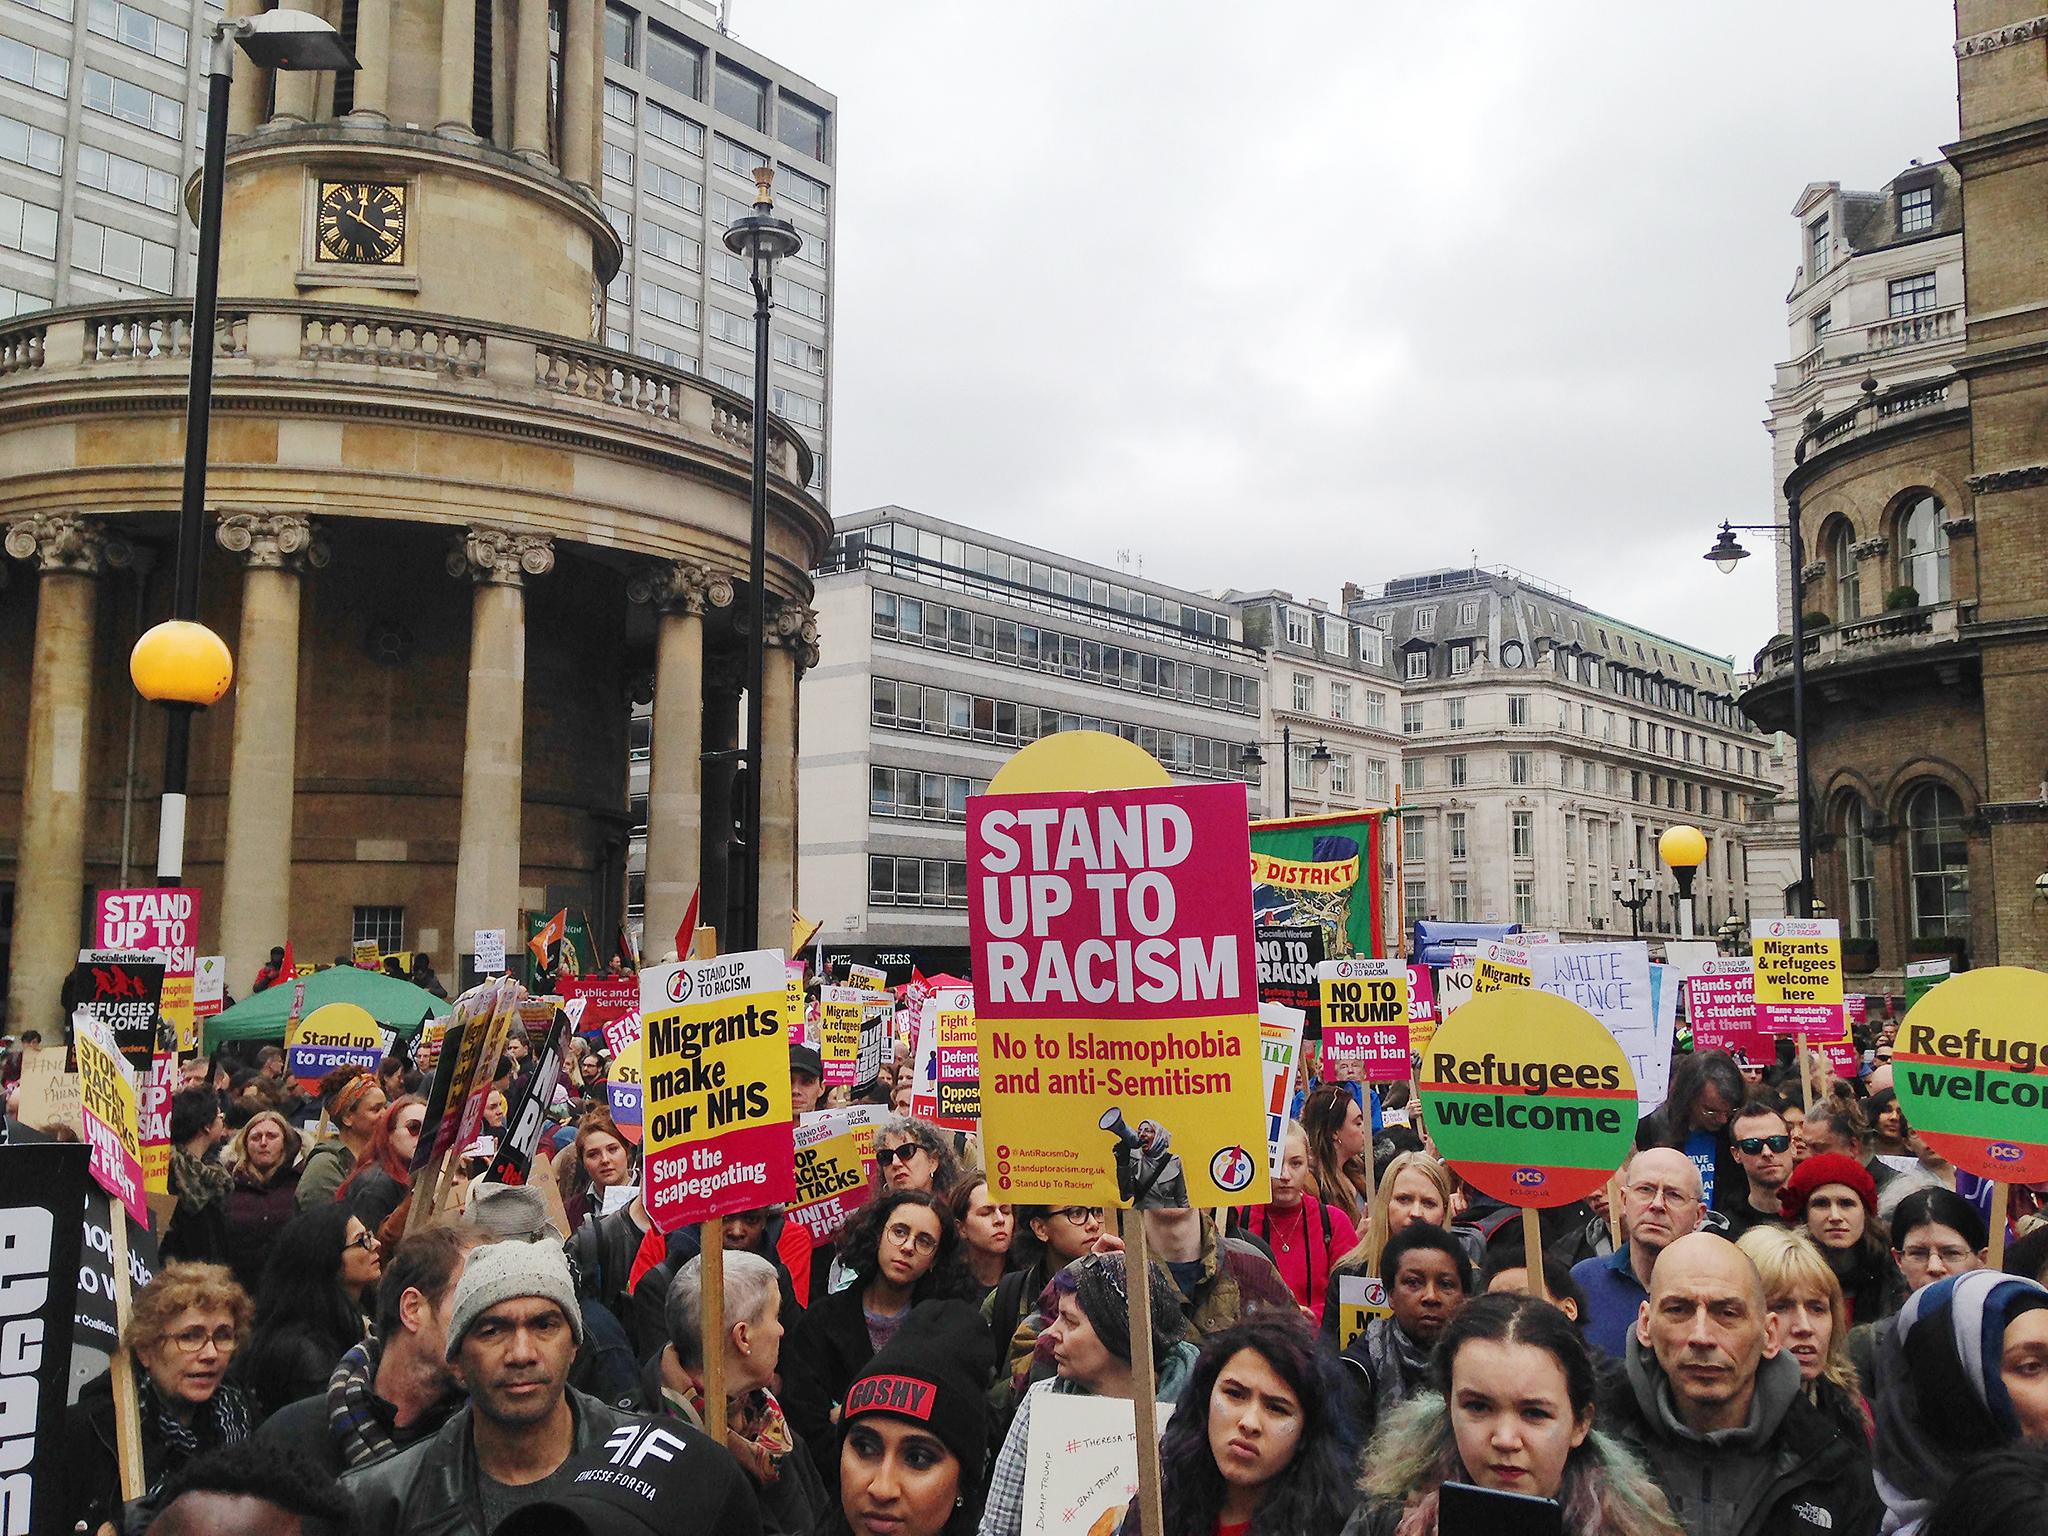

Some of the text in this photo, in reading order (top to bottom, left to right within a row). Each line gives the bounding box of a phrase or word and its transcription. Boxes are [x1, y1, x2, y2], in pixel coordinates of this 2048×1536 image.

[980, 804, 1193, 873] STAND
[1266, 863, 1352, 885] DISTRICT
[104, 894, 192, 922] STAND
[982, 871, 1176, 938] UP TO
[104, 921, 185, 948] UP TO
[1259, 930, 1286, 938] Socialist
[1256, 941, 1308, 962] NO TO
[1764, 941, 1828, 956] Migrants
[128, 953, 156, 963] Worker
[1506, 956, 1527, 966] RACISM
[1554, 952, 1623, 981] WHITE
[1758, 957, 1836, 972] & refugees
[697, 962, 744, 982] STAND UP
[987, 934, 1240, 1004] RACISM
[1257, 961, 1319, 984] RACISM
[1482, 963, 1531, 987] Migrants
[698, 976, 751, 998] TO RACISM
[850, 974, 870, 984] STOP
[1446, 972, 1473, 991] NO
[1475, 979, 1483, 992] &
[1692, 977, 1753, 991] Hands off
[1767, 972, 1829, 985] welcome
[575, 988, 608, 997] Public
[609, 988, 629, 997] and
[1331, 982, 1361, 1002] NO
[1368, 982, 1396, 1002] TO
[1693, 993, 1710, 1004] EU
[1783, 987, 1815, 1000] here
[597, 998, 640, 1007] Services
[1694, 1005, 1756, 1017] & student
[1766, 1006, 1791, 1014] Blame
[826, 1005, 859, 1019] Migrants
[1327, 1002, 1402, 1022] TRUMP
[1774, 1015, 1827, 1024] not migrants
[822, 1020, 860, 1033] & refugees
[940, 1015, 968, 1029] Fight
[1696, 1019, 1717, 1030] Let
[1719, 1017, 1751, 1030] them
[648, 1004, 779, 1059] Migrants
[826, 1033, 857, 1044] welcome
[941, 1030, 976, 1041] Islamo
[1335, 1032, 1353, 1045] No
[1356, 1032, 1370, 1045] to
[1374, 1031, 1396, 1044] the
[1697, 1034, 1723, 1046] stay
[301, 1031, 350, 1047] Stand
[354, 1036, 374, 1051] up
[80, 1036, 117, 1080] STOP
[296, 1051, 374, 1067] to racism
[833, 1045, 850, 1057] here
[992, 1033, 1027, 1060] No
[1035, 1033, 1060, 1059] to
[1068, 1030, 1242, 1071] Islamophobia
[1327, 1046, 1405, 1060] Muslim ban
[1835, 1057, 1852, 1065] ban
[650, 1056, 726, 1103] make
[994, 1067, 1232, 1098] and anti-Semitism
[1433, 1053, 1619, 1095] Refugees
[1908, 1071, 2048, 1108] welco
[613, 1090, 637, 1107] to
[942, 1101, 981, 1113] Preven
[651, 1081, 769, 1143] our NHS
[917, 1105, 935, 1116] LET
[1435, 1096, 1620, 1134] welcome
[795, 1125, 828, 1139] STAND UP
[798, 1130, 833, 1147] TO RACISM
[1991, 1145, 2020, 1158] pcs
[653, 1148, 722, 1183] Stop the
[1012, 1163, 1106, 1176] standuptoracism.org.uk
[654, 1161, 767, 1208] scapegoating
[1515, 1170, 1542, 1183] pcs
[785, 1169, 860, 1206] TTACKS
[1039, 1181, 1051, 1190] Up
[1053, 1181, 1062, 1189] To
[788, 1197, 843, 1225] UNITE
[811, 1207, 860, 1238] FIG
[850, 1379, 927, 1410] GOSHY
[574, 1469, 657, 1501] FINESSE FOREVA
[1095, 1465, 1120, 1489] TRUMP
[1036, 1452, 1052, 1530] DUMP TRUMP
